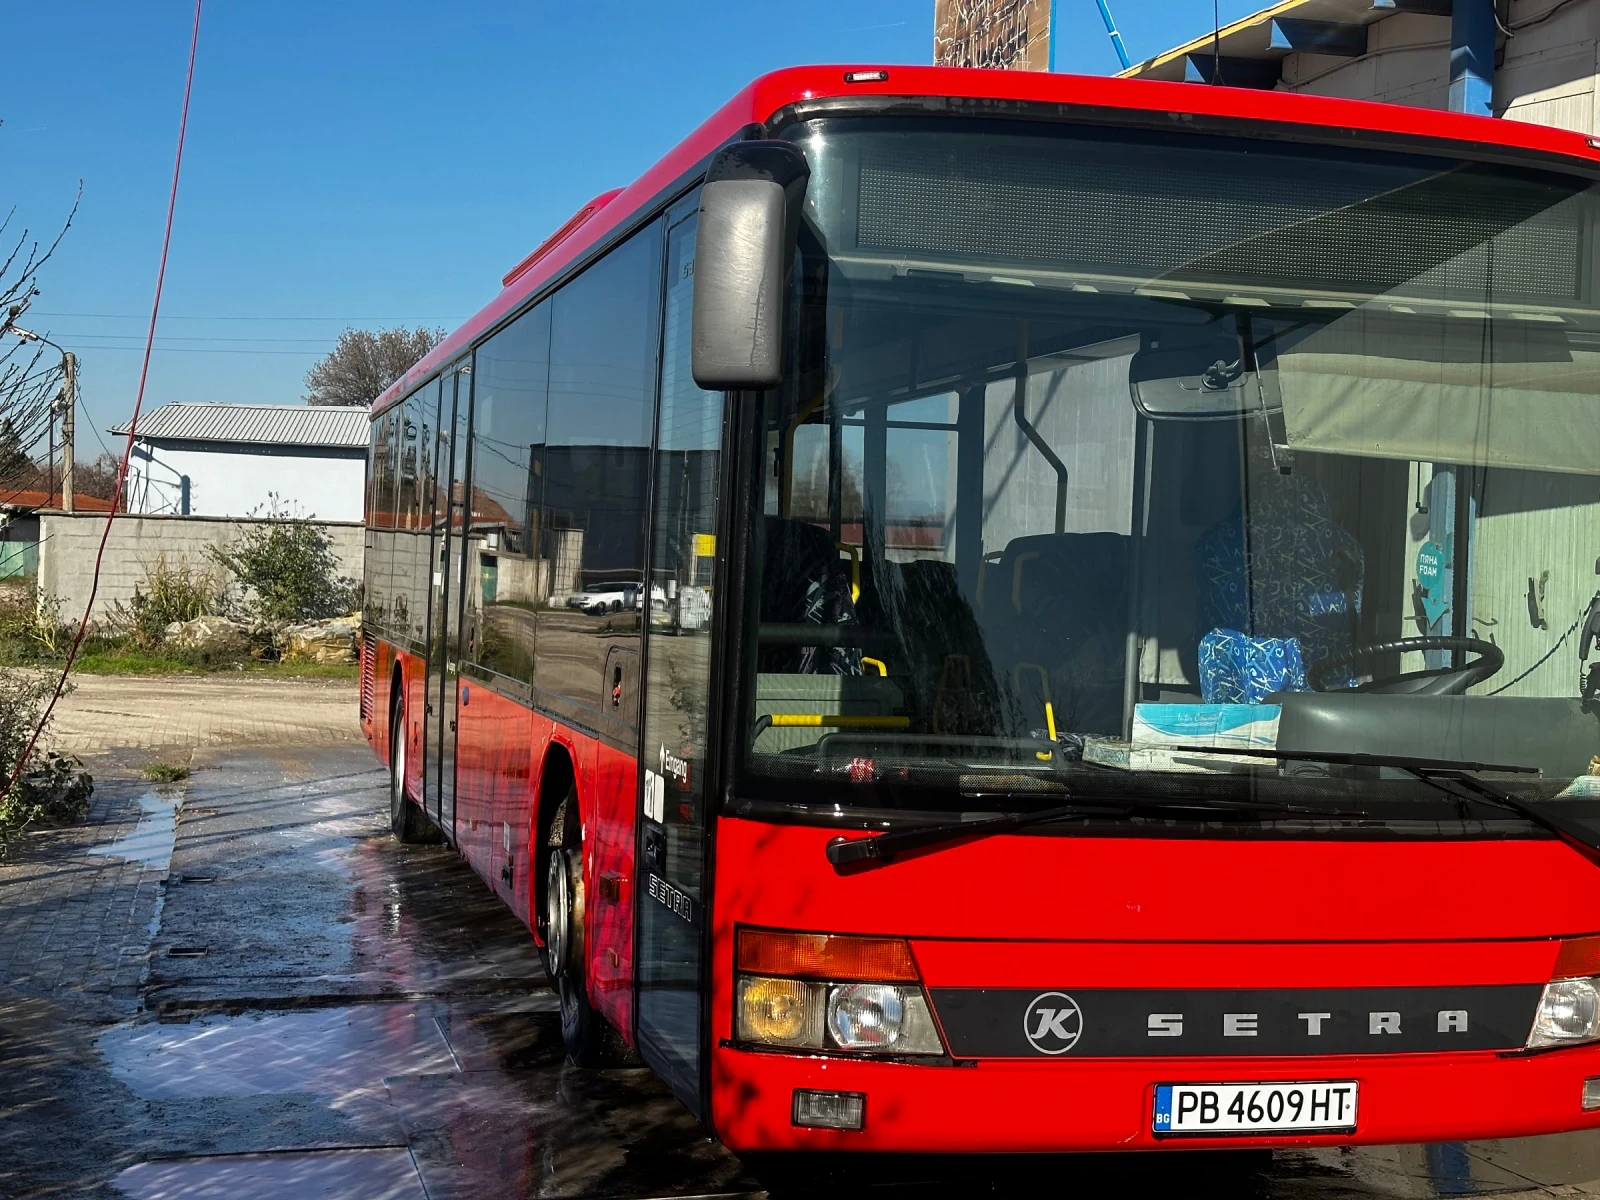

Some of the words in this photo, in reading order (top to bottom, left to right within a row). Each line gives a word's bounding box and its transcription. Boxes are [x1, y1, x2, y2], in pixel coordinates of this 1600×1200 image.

[1419, 565, 1438, 577] FOAM
[1420, 553, 1438, 566] ПЯНА
[665, 749, 687, 784] Eingang
[649, 873, 692, 922] SETRA
[1147, 1009, 1469, 1037] SETRA
[1156, 1113, 1170, 1124] BG
[1177, 1091, 1219, 1125] PB
[1227, 1089, 1304, 1124] 4609
[1310, 1088, 1351, 1122] HT
